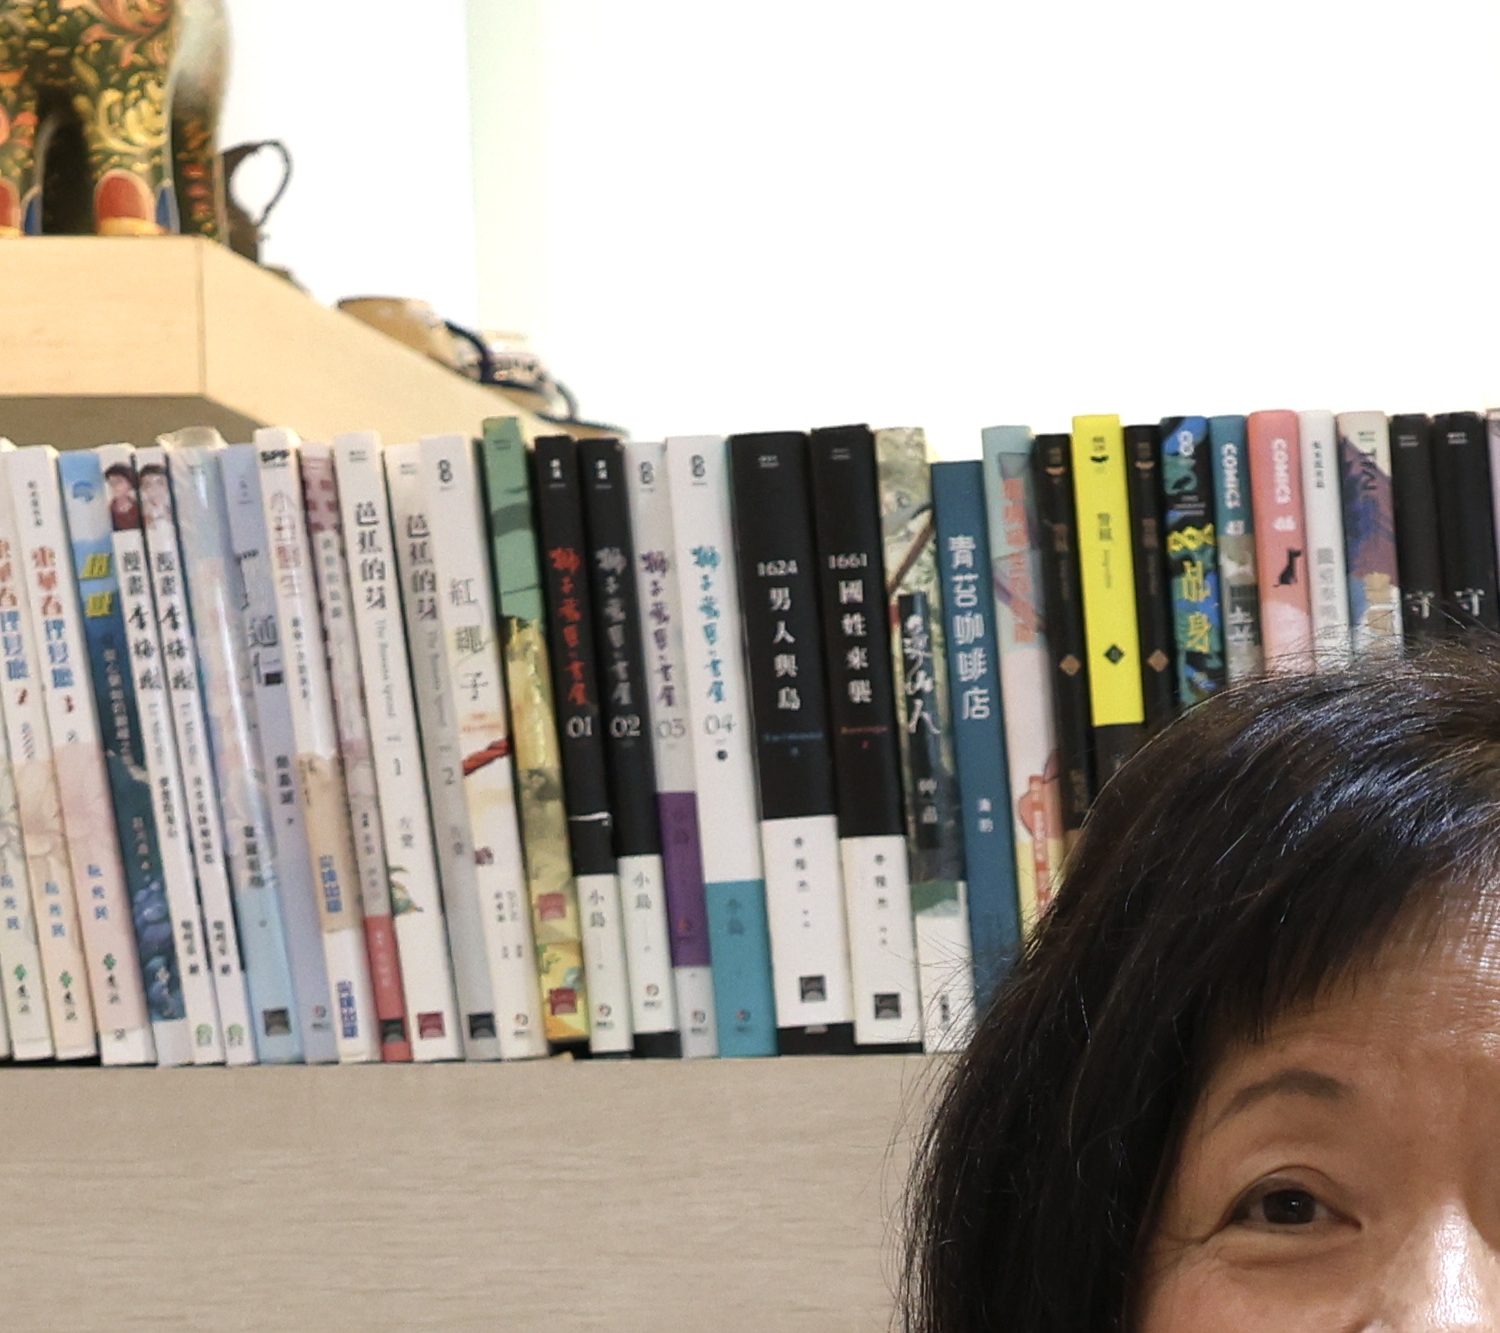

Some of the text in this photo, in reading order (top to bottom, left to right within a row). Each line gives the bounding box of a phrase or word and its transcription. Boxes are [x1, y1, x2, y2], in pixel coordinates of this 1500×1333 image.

[1221, 443, 1241, 509] COMICS
[1272, 439, 1292, 504] COMICS
[354, 502, 390, 612] 芭蕉的芽
[405, 514, 440, 621] 芭蕉的芽
[757, 560, 801, 711] 1624 男人與島
[829, 553, 872, 703] 1661 國姓來襲
[949, 535, 990, 720] 青苔咖啡店
[566, 716, 593, 738] 01
[610, 715, 641, 738] 02
[655, 718, 685, 739] 03
[704, 715, 735, 736] 04
